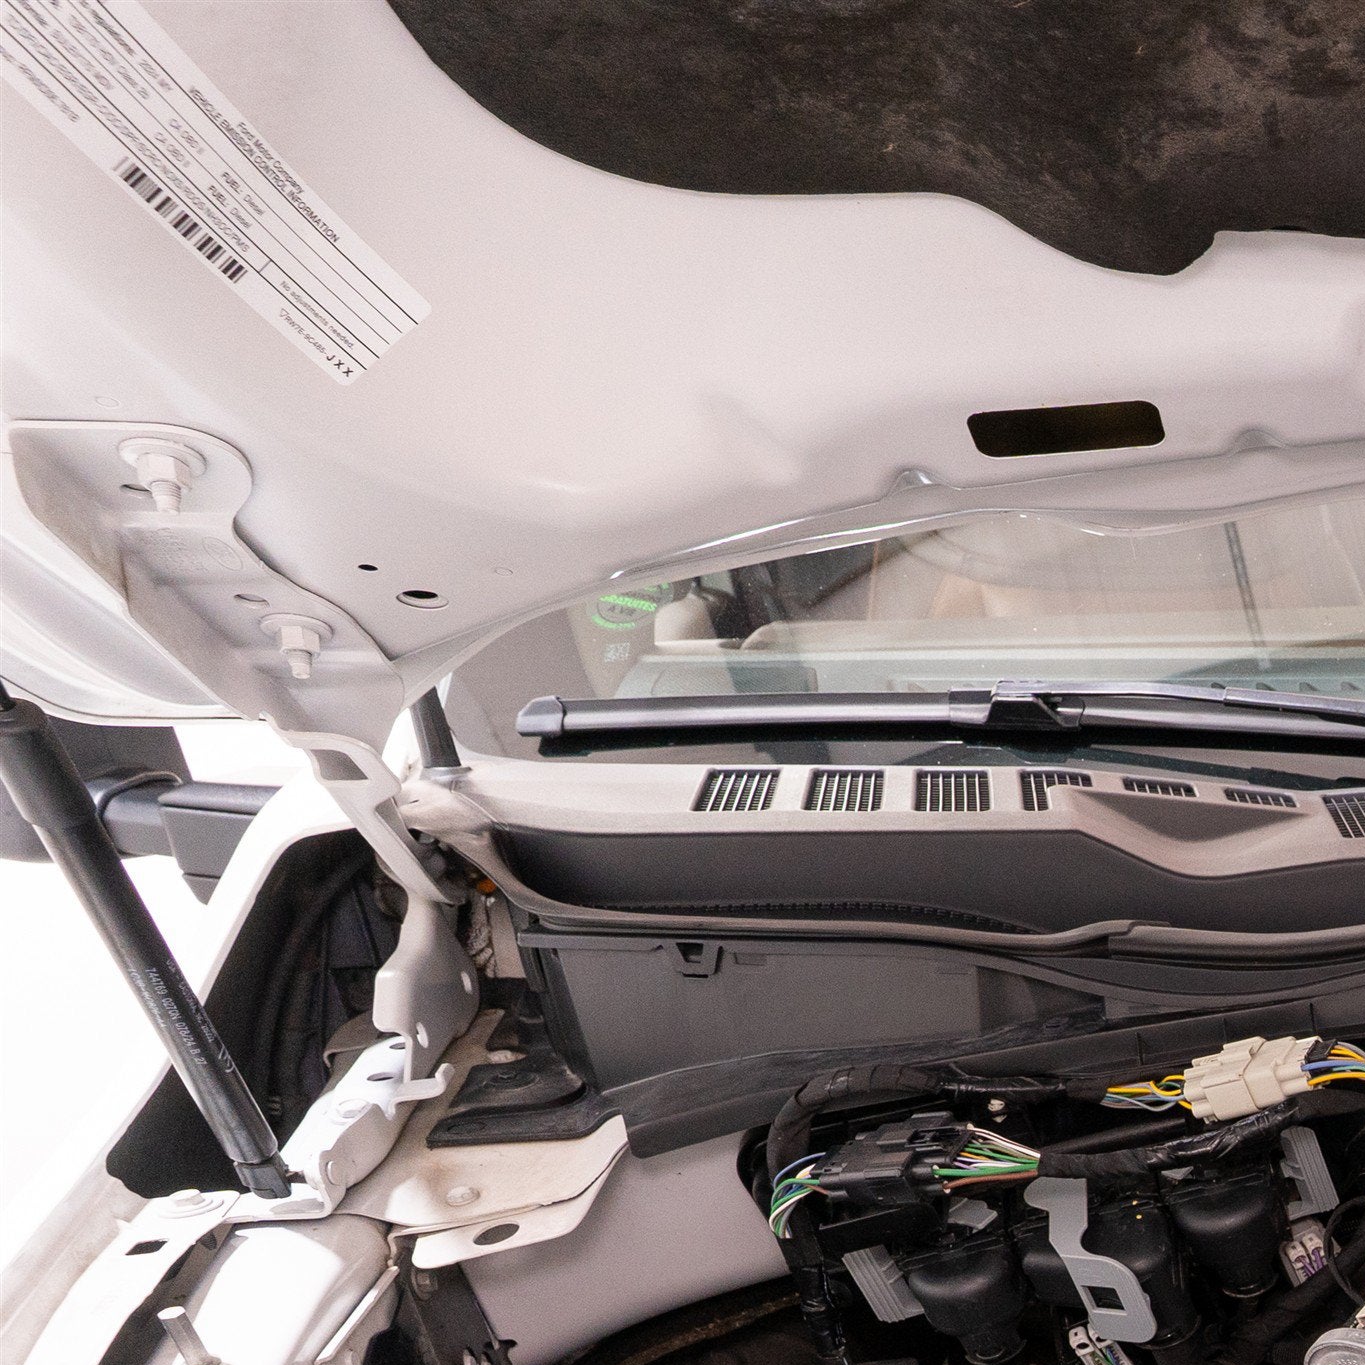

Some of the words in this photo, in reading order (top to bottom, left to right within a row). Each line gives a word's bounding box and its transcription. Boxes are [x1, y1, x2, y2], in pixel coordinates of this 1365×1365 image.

[190, 89, 222, 121] VEHICLE
[220, 120, 255, 157] EMISSION
[254, 156, 286, 192] CONTROL
[288, 190, 339, 245] INFORMATION
[222, 172, 242, 194] FUEL:
[243, 194, 264, 216] Diesel
[238, 122, 254, 141] Ford
[253, 139, 274, 161] Motor
[273, 160, 303, 194] Company
